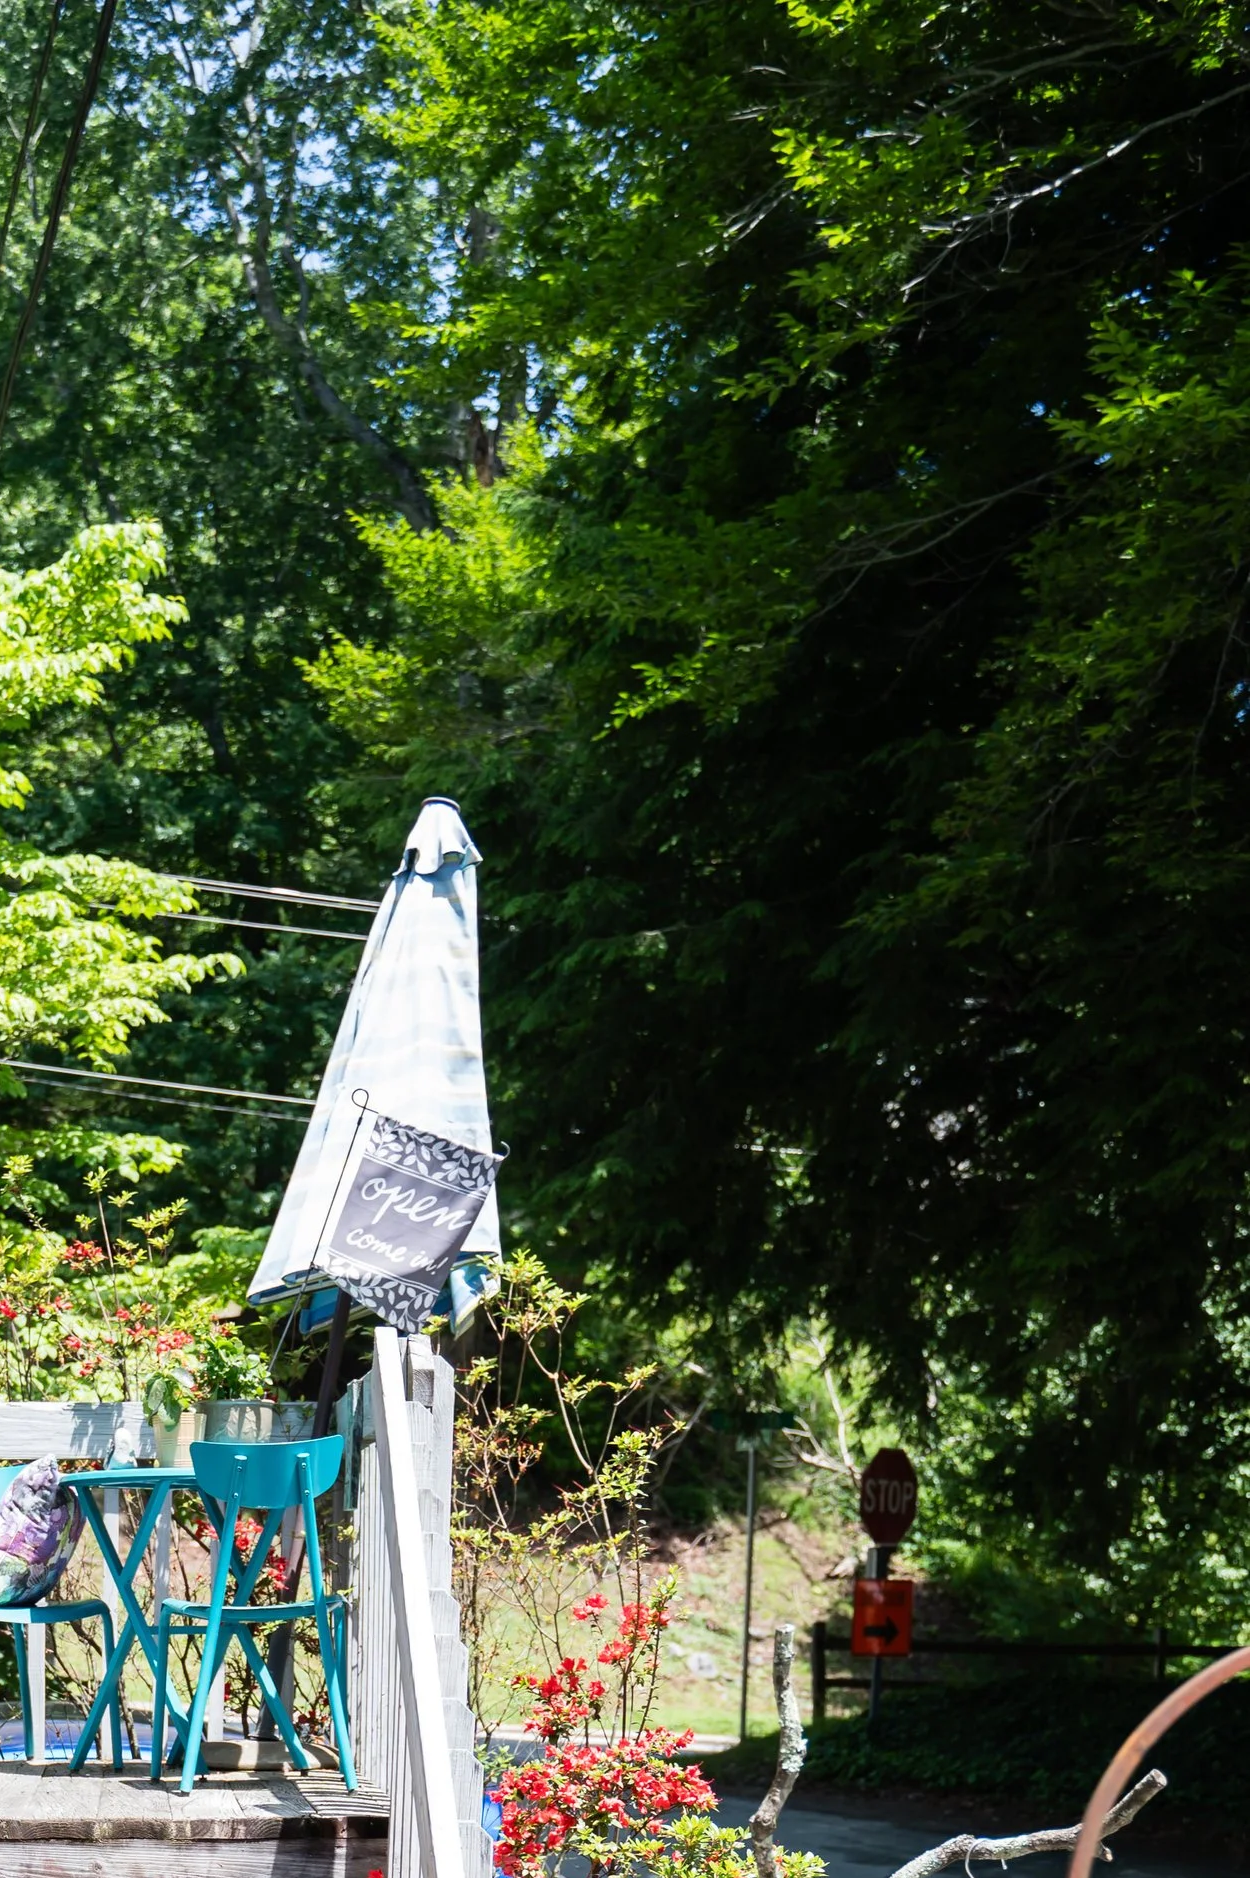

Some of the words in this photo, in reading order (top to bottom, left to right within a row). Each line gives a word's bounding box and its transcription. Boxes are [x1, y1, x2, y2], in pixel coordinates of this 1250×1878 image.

[361, 1177, 472, 1230] open
[346, 1228, 407, 1263] come
[410, 1250, 449, 1275] in!
[863, 1477, 915, 1515] STOP
